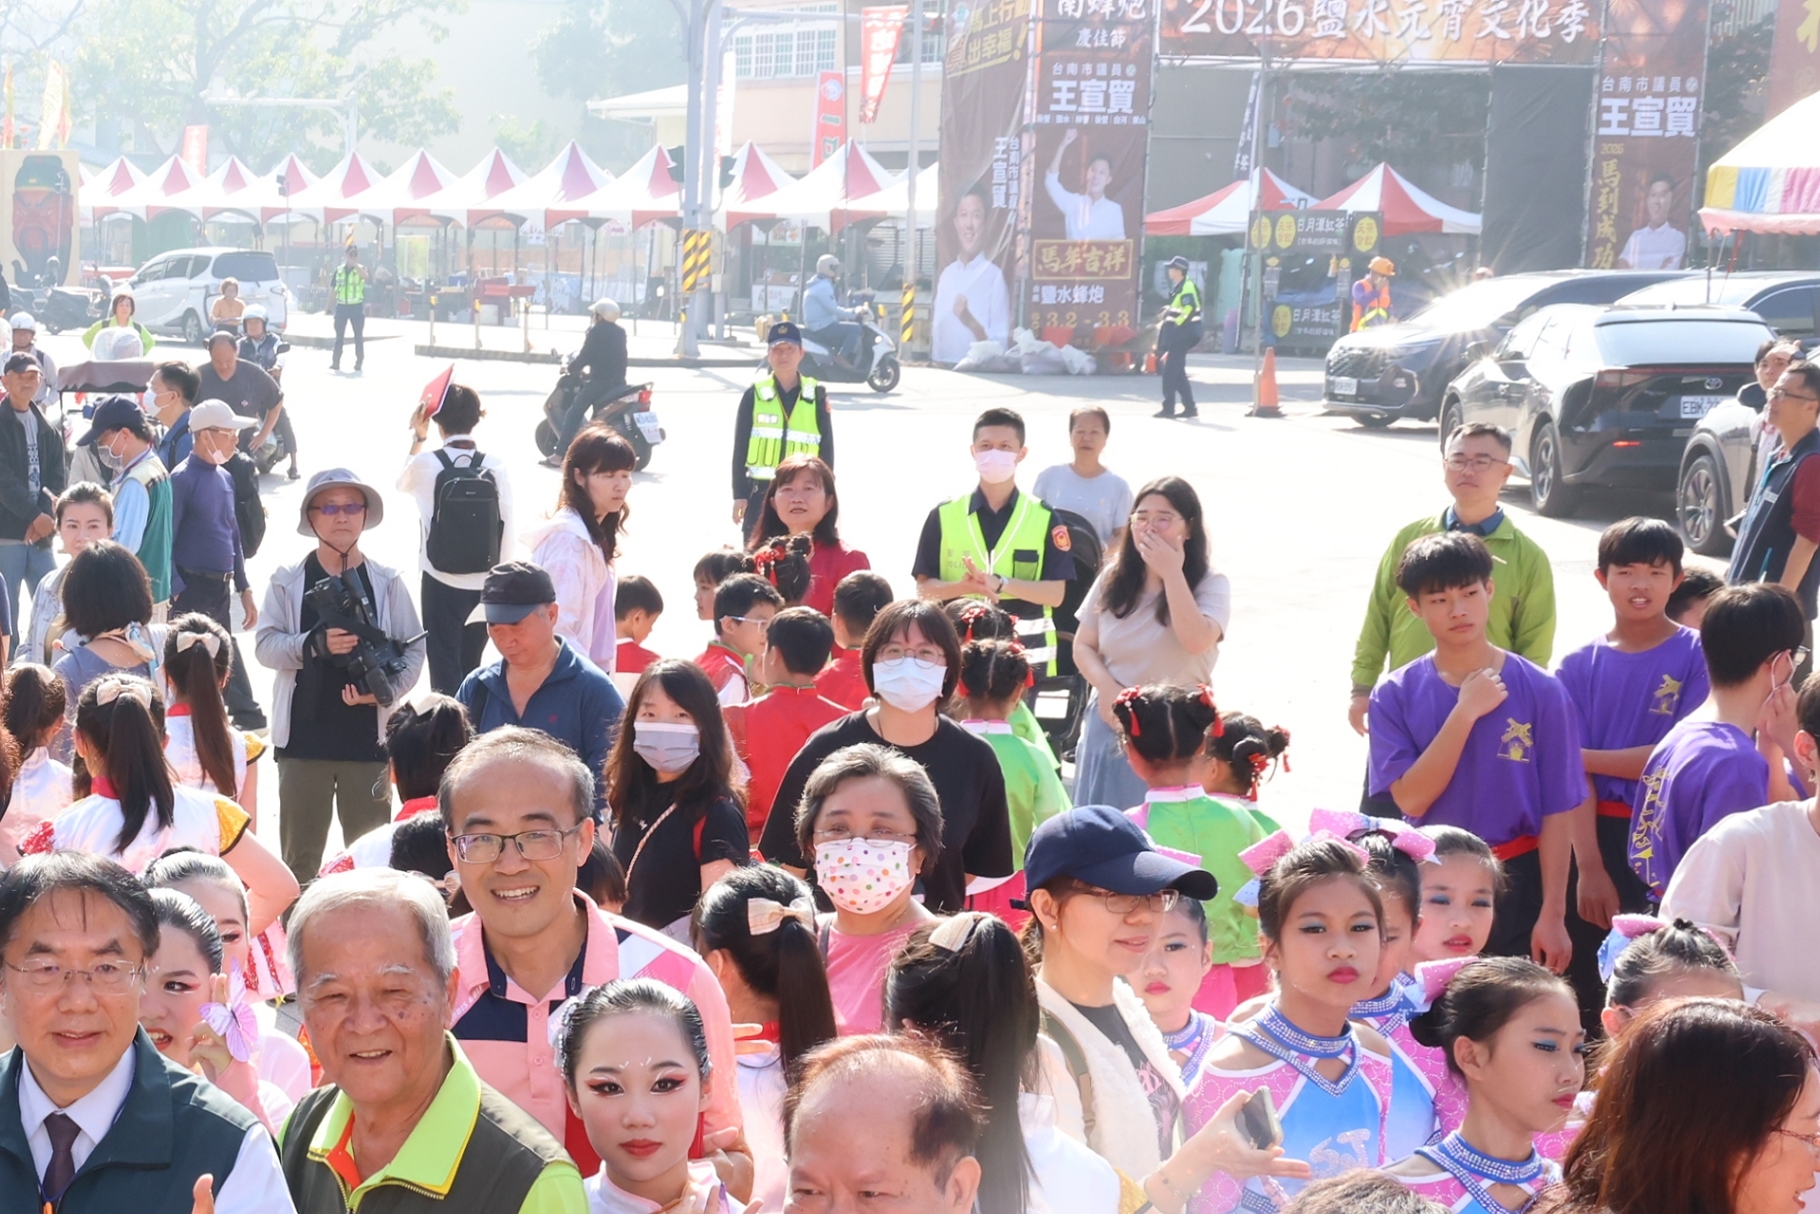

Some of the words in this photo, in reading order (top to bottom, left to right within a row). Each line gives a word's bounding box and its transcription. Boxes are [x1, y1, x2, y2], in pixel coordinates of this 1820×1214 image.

[1075, 27, 1128, 49] 慶佳節
[1052, 62, 1122, 77] 台南市議員
[1601, 76, 1682, 93] 台南市議員
[1049, 79, 1136, 114] 王宣貿
[1598, 96, 1697, 138] 王宣貿
[1037, 244, 1127, 276] 馬年吉祥
[1041, 284, 1105, 305] 鹽水蜂炮
